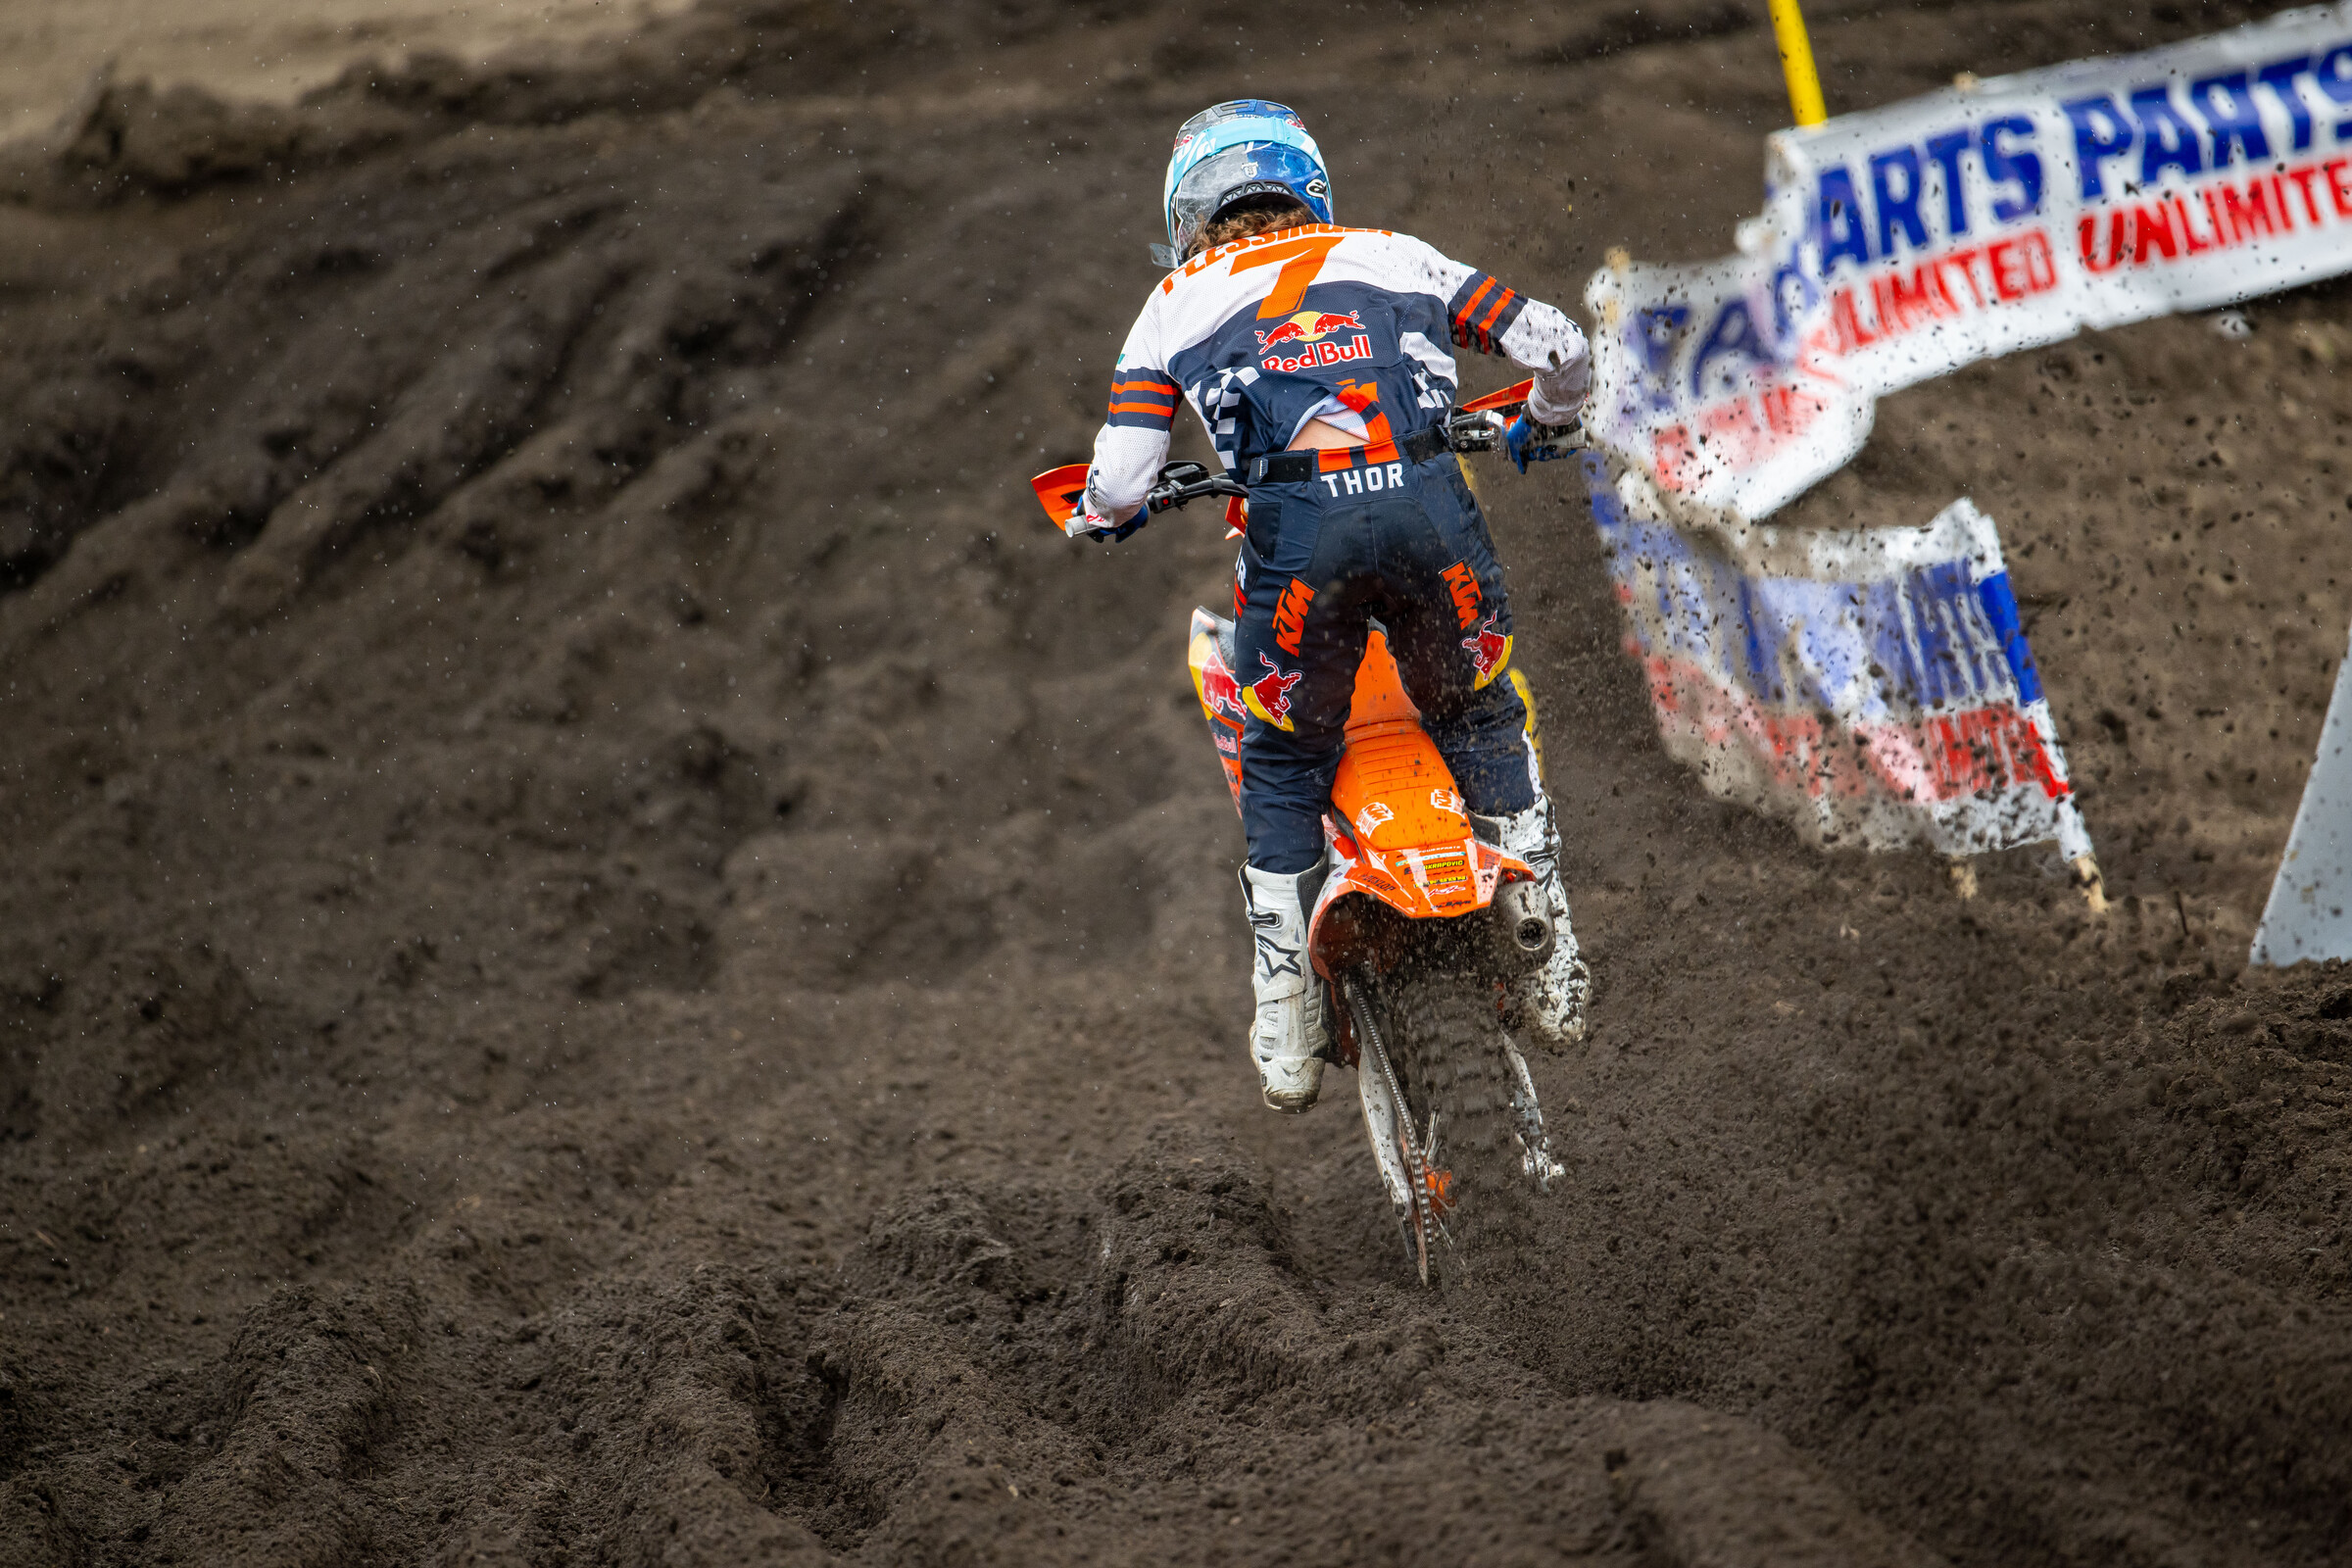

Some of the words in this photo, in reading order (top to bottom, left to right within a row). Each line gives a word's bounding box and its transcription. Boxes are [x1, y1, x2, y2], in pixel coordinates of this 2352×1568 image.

[1228, 236, 1346, 321] 7
[1317, 334, 1374, 367] Bull
[1320, 463, 1404, 498] THOR
[1272, 577, 1315, 658] KTM
[1442, 562, 1483, 630] KTM
